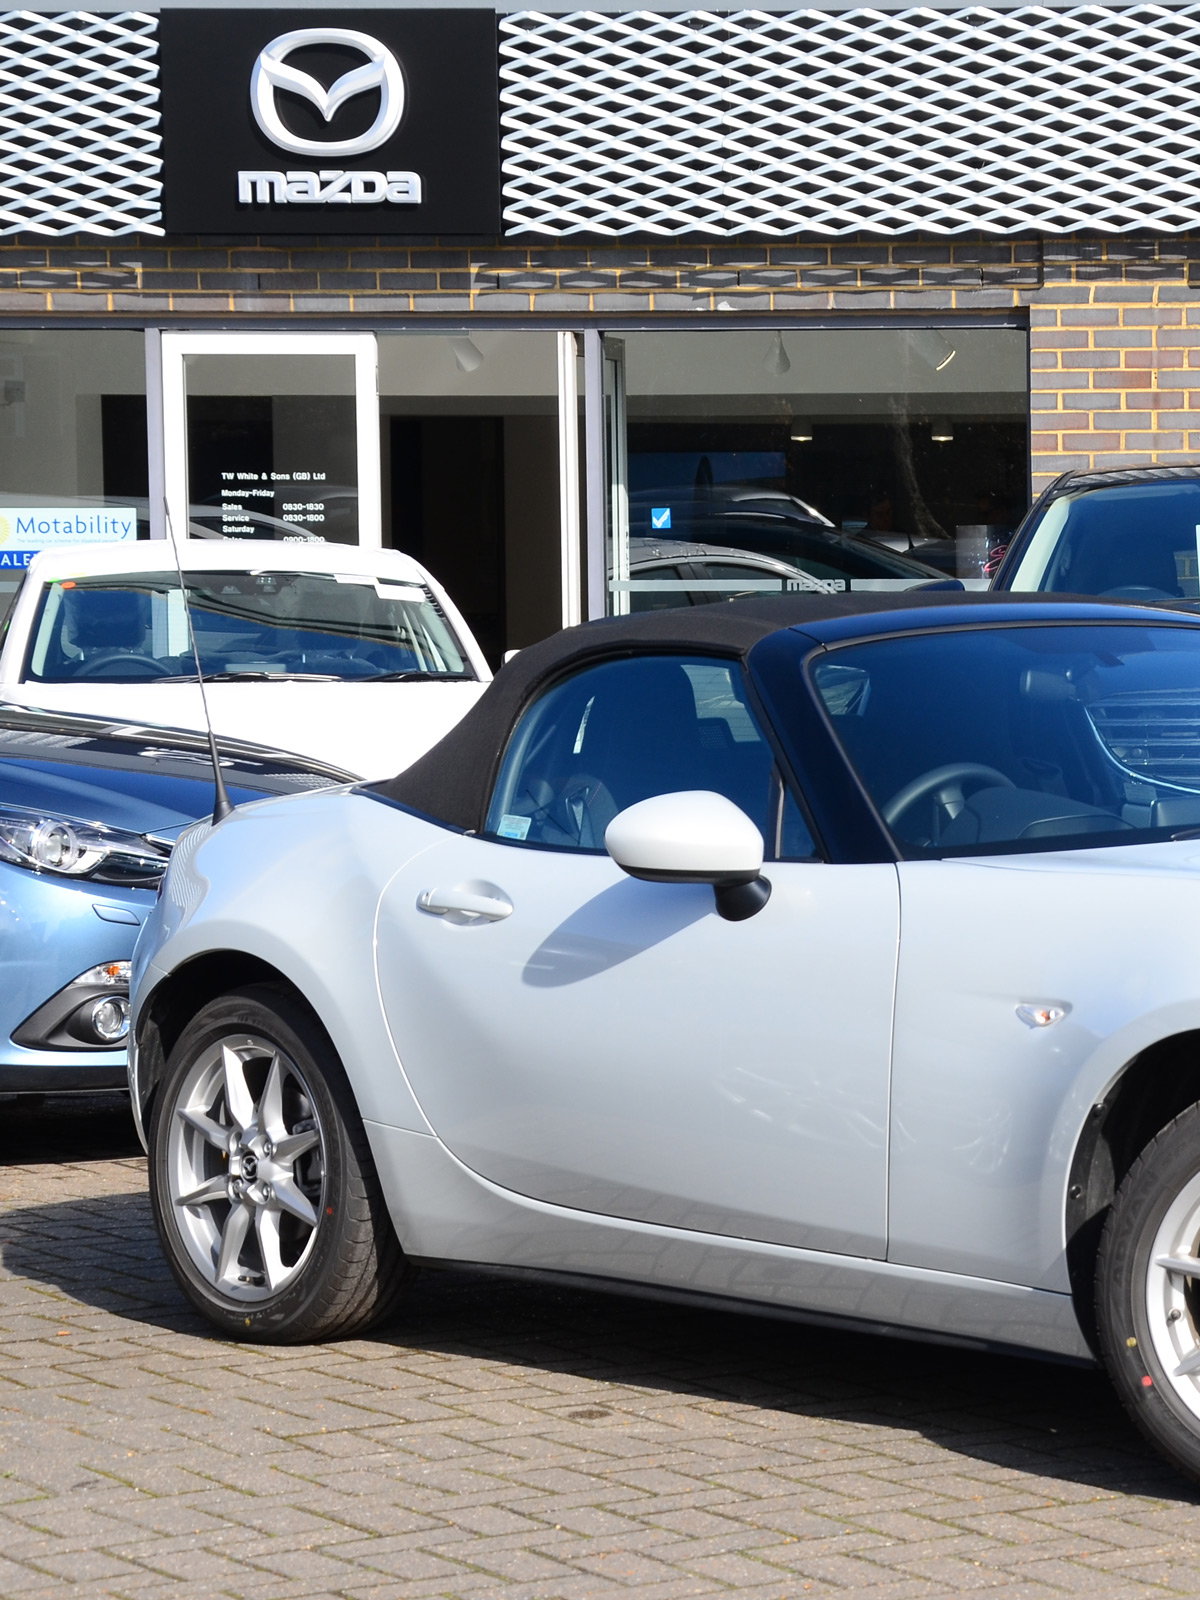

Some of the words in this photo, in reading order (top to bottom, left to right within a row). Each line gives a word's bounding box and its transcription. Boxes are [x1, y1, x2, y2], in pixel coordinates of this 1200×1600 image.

[221, 472, 235, 480] TW
[237, 472, 259, 480] White
[261, 472, 268, 480] &
[270, 472, 290, 480] Sons
[292, 472, 311, 481] (GB)
[313, 472, 326, 480] Ltd
[221, 489, 275, 498] Monday-Friday
[222, 503, 243, 511] Sales
[222, 514, 250, 522] Service
[16, 514, 131, 539] Motability
[222, 525, 255, 533] Saturday
